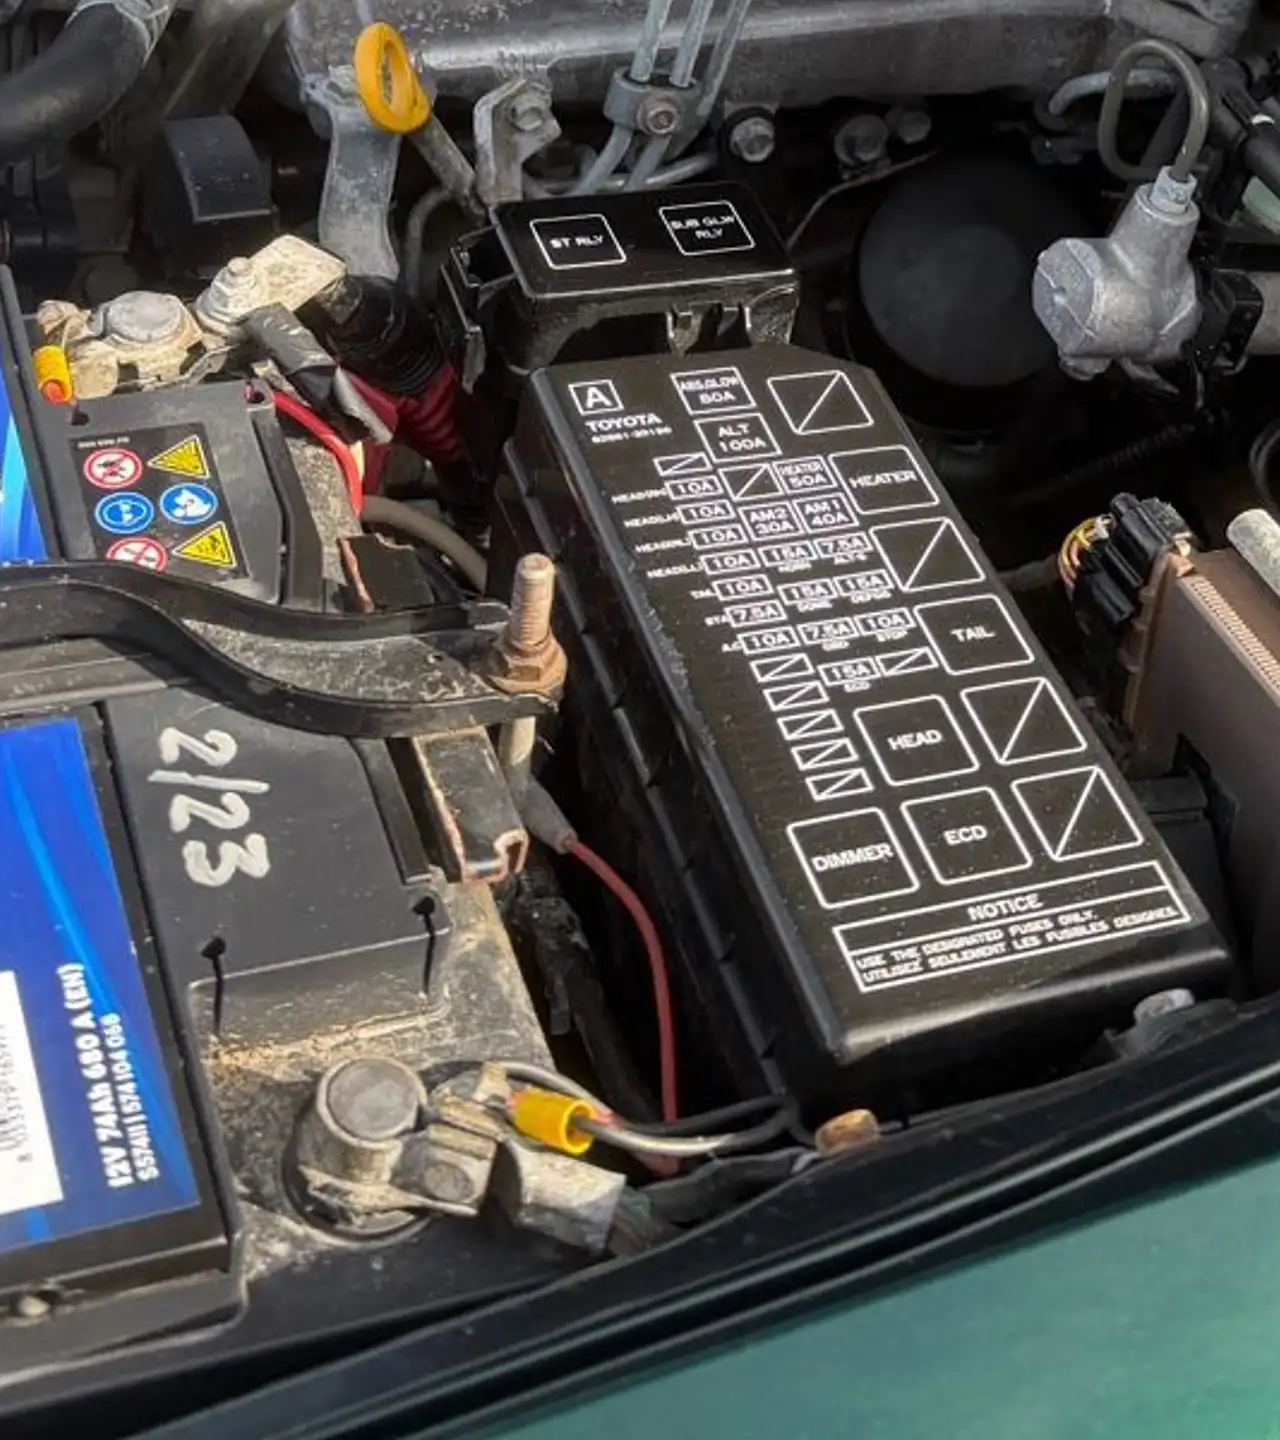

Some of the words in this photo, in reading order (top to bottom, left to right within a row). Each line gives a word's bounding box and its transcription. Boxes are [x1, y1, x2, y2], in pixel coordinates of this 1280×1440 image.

[550, 237, 571, 249] ST
[576, 234, 603, 247] RLY
[695, 228, 723, 240] RLY
[585, 385, 613, 409] A
[584, 412, 663, 433] TOYOTA
[718, 423, 750, 437] ALT
[720, 437, 768, 454] 100A
[780, 460, 824, 475] HEATER
[677, 479, 715, 495] 10A
[848, 470, 918, 489] HEATER
[689, 504, 727, 520] 10A
[750, 508, 788, 522] AM2
[804, 500, 841, 515] AM1
[754, 521, 795, 535] 30A
[811, 512, 849, 527] 40A
[700, 529, 738, 545] 10A
[712, 554, 751, 570] 10A
[770, 545, 809, 562] 15A
[725, 578, 763, 595] 10A
[846, 575, 885, 590] 15A
[790, 584, 830, 600] 15A
[867, 613, 906, 629] 10A
[749, 633, 790, 648] 10A
[949, 625, 997, 642] TAIL
[831, 663, 870, 679] 15A
[887, 729, 944, 751] HEAD
[147, 726, 271, 888] 2/23
[943, 824, 988, 846] ECD
[810, 841, 895, 872] DIMMER
[966, 892, 1045, 922] NOTICE
[1011, 935, 1043, 951] LES
[855, 953, 887, 970] USE
[55, 962, 93, 1010] (EN)
[70, 1011, 97, 1029] A
[75, 1032, 108, 1080] 680
[115, 1081, 143, 1115] 574
[86, 1082, 124, 1143] 74Ah
[99, 1146, 135, 1188] 12V
